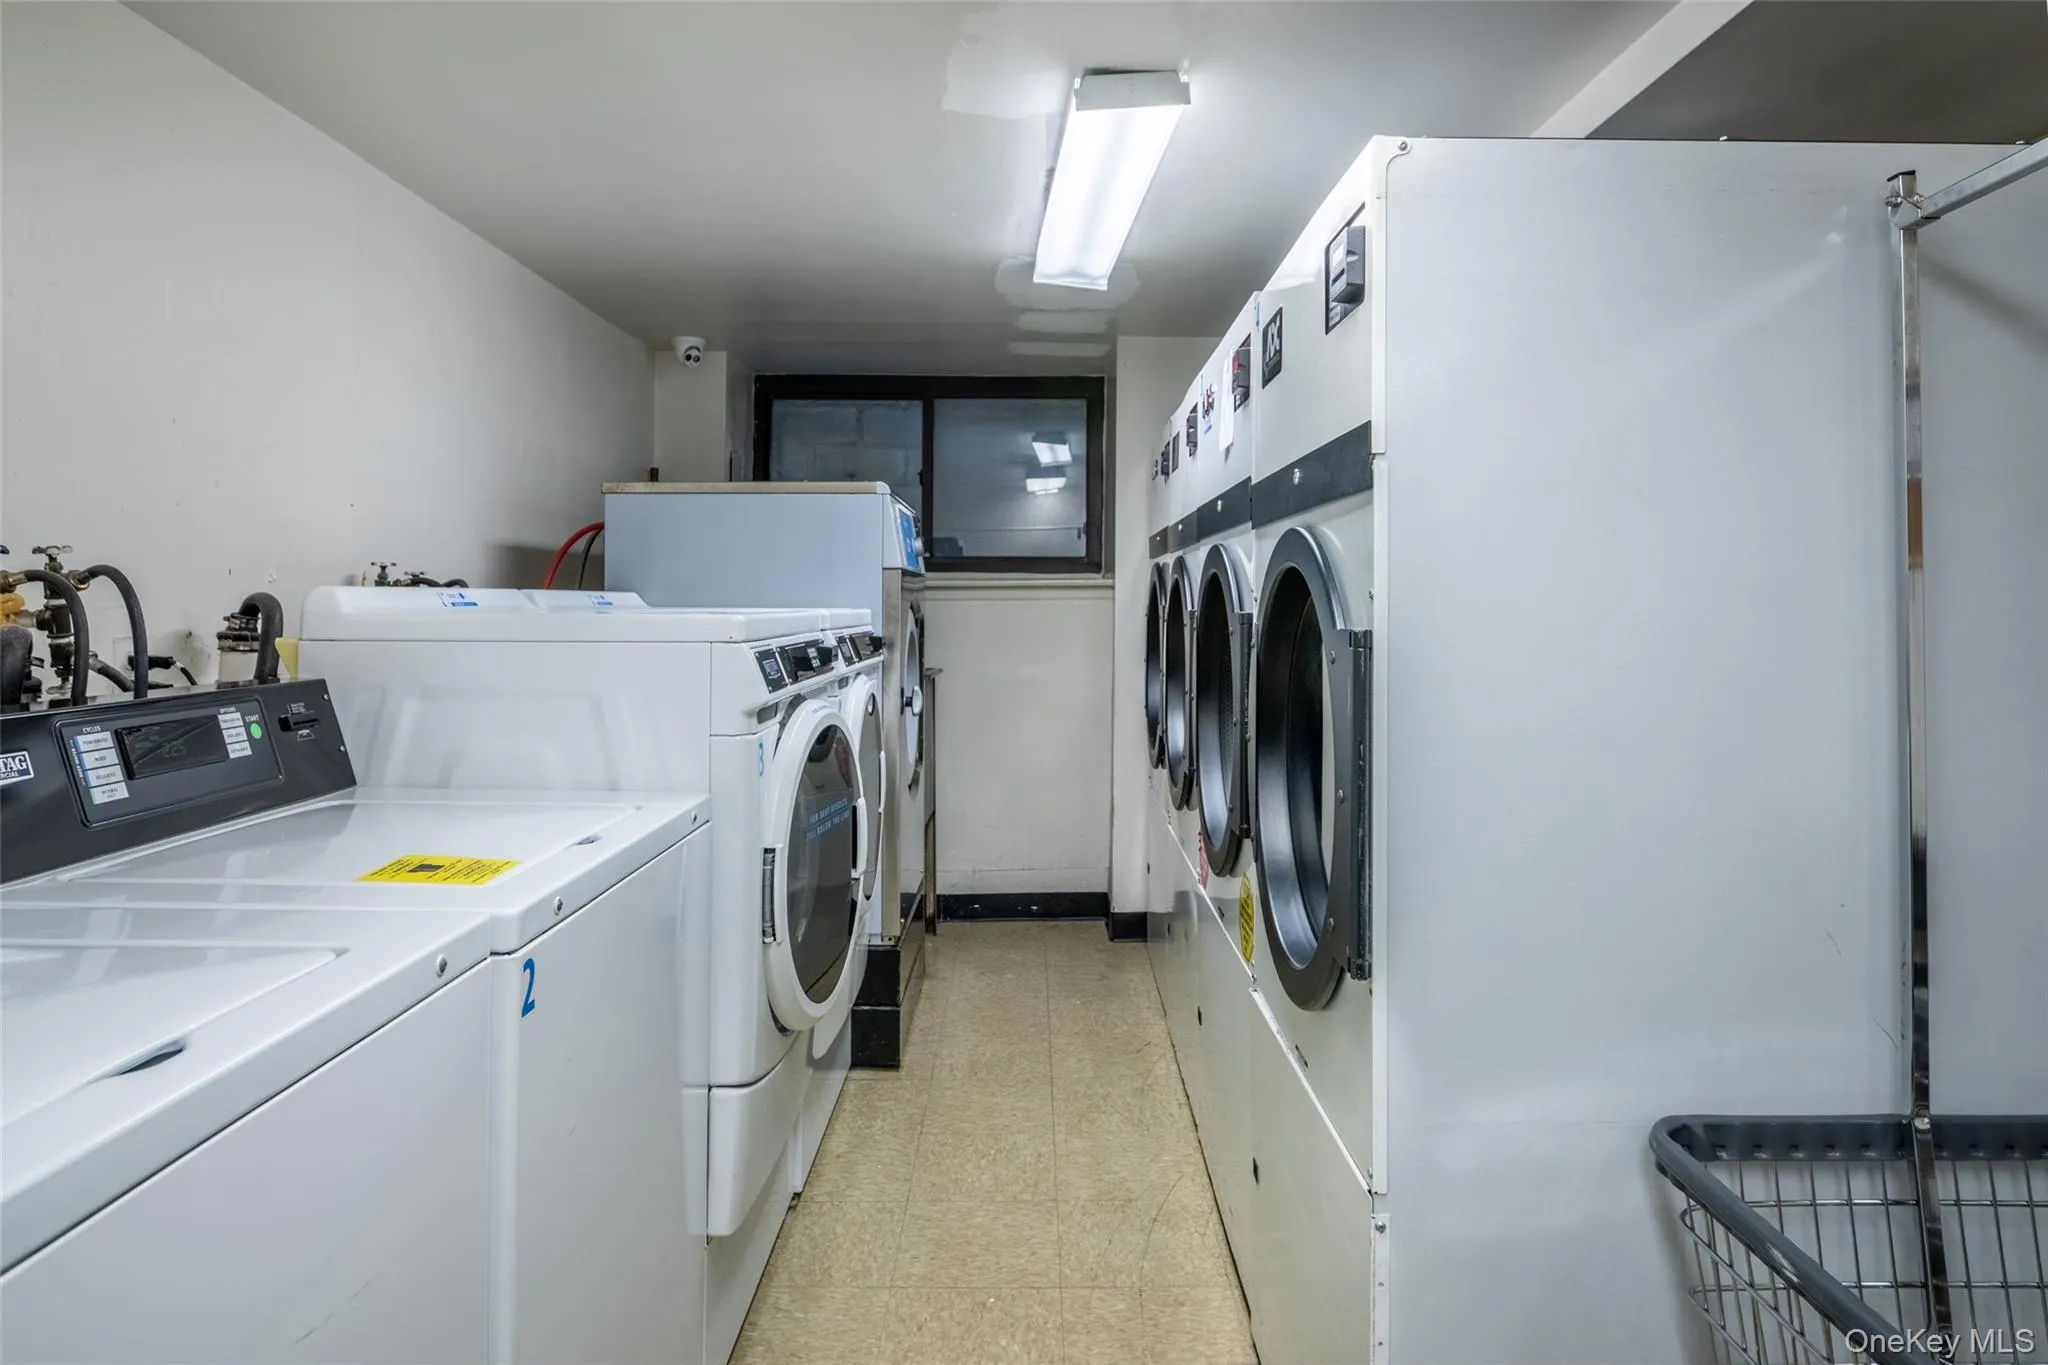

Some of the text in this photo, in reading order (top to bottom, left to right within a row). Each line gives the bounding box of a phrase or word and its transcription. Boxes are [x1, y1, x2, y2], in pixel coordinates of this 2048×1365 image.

[245, 714, 260, 722] START
[83, 726, 101, 734] CYCLES
[758, 741, 764, 777] 3
[521, 958, 535, 1018] 2
